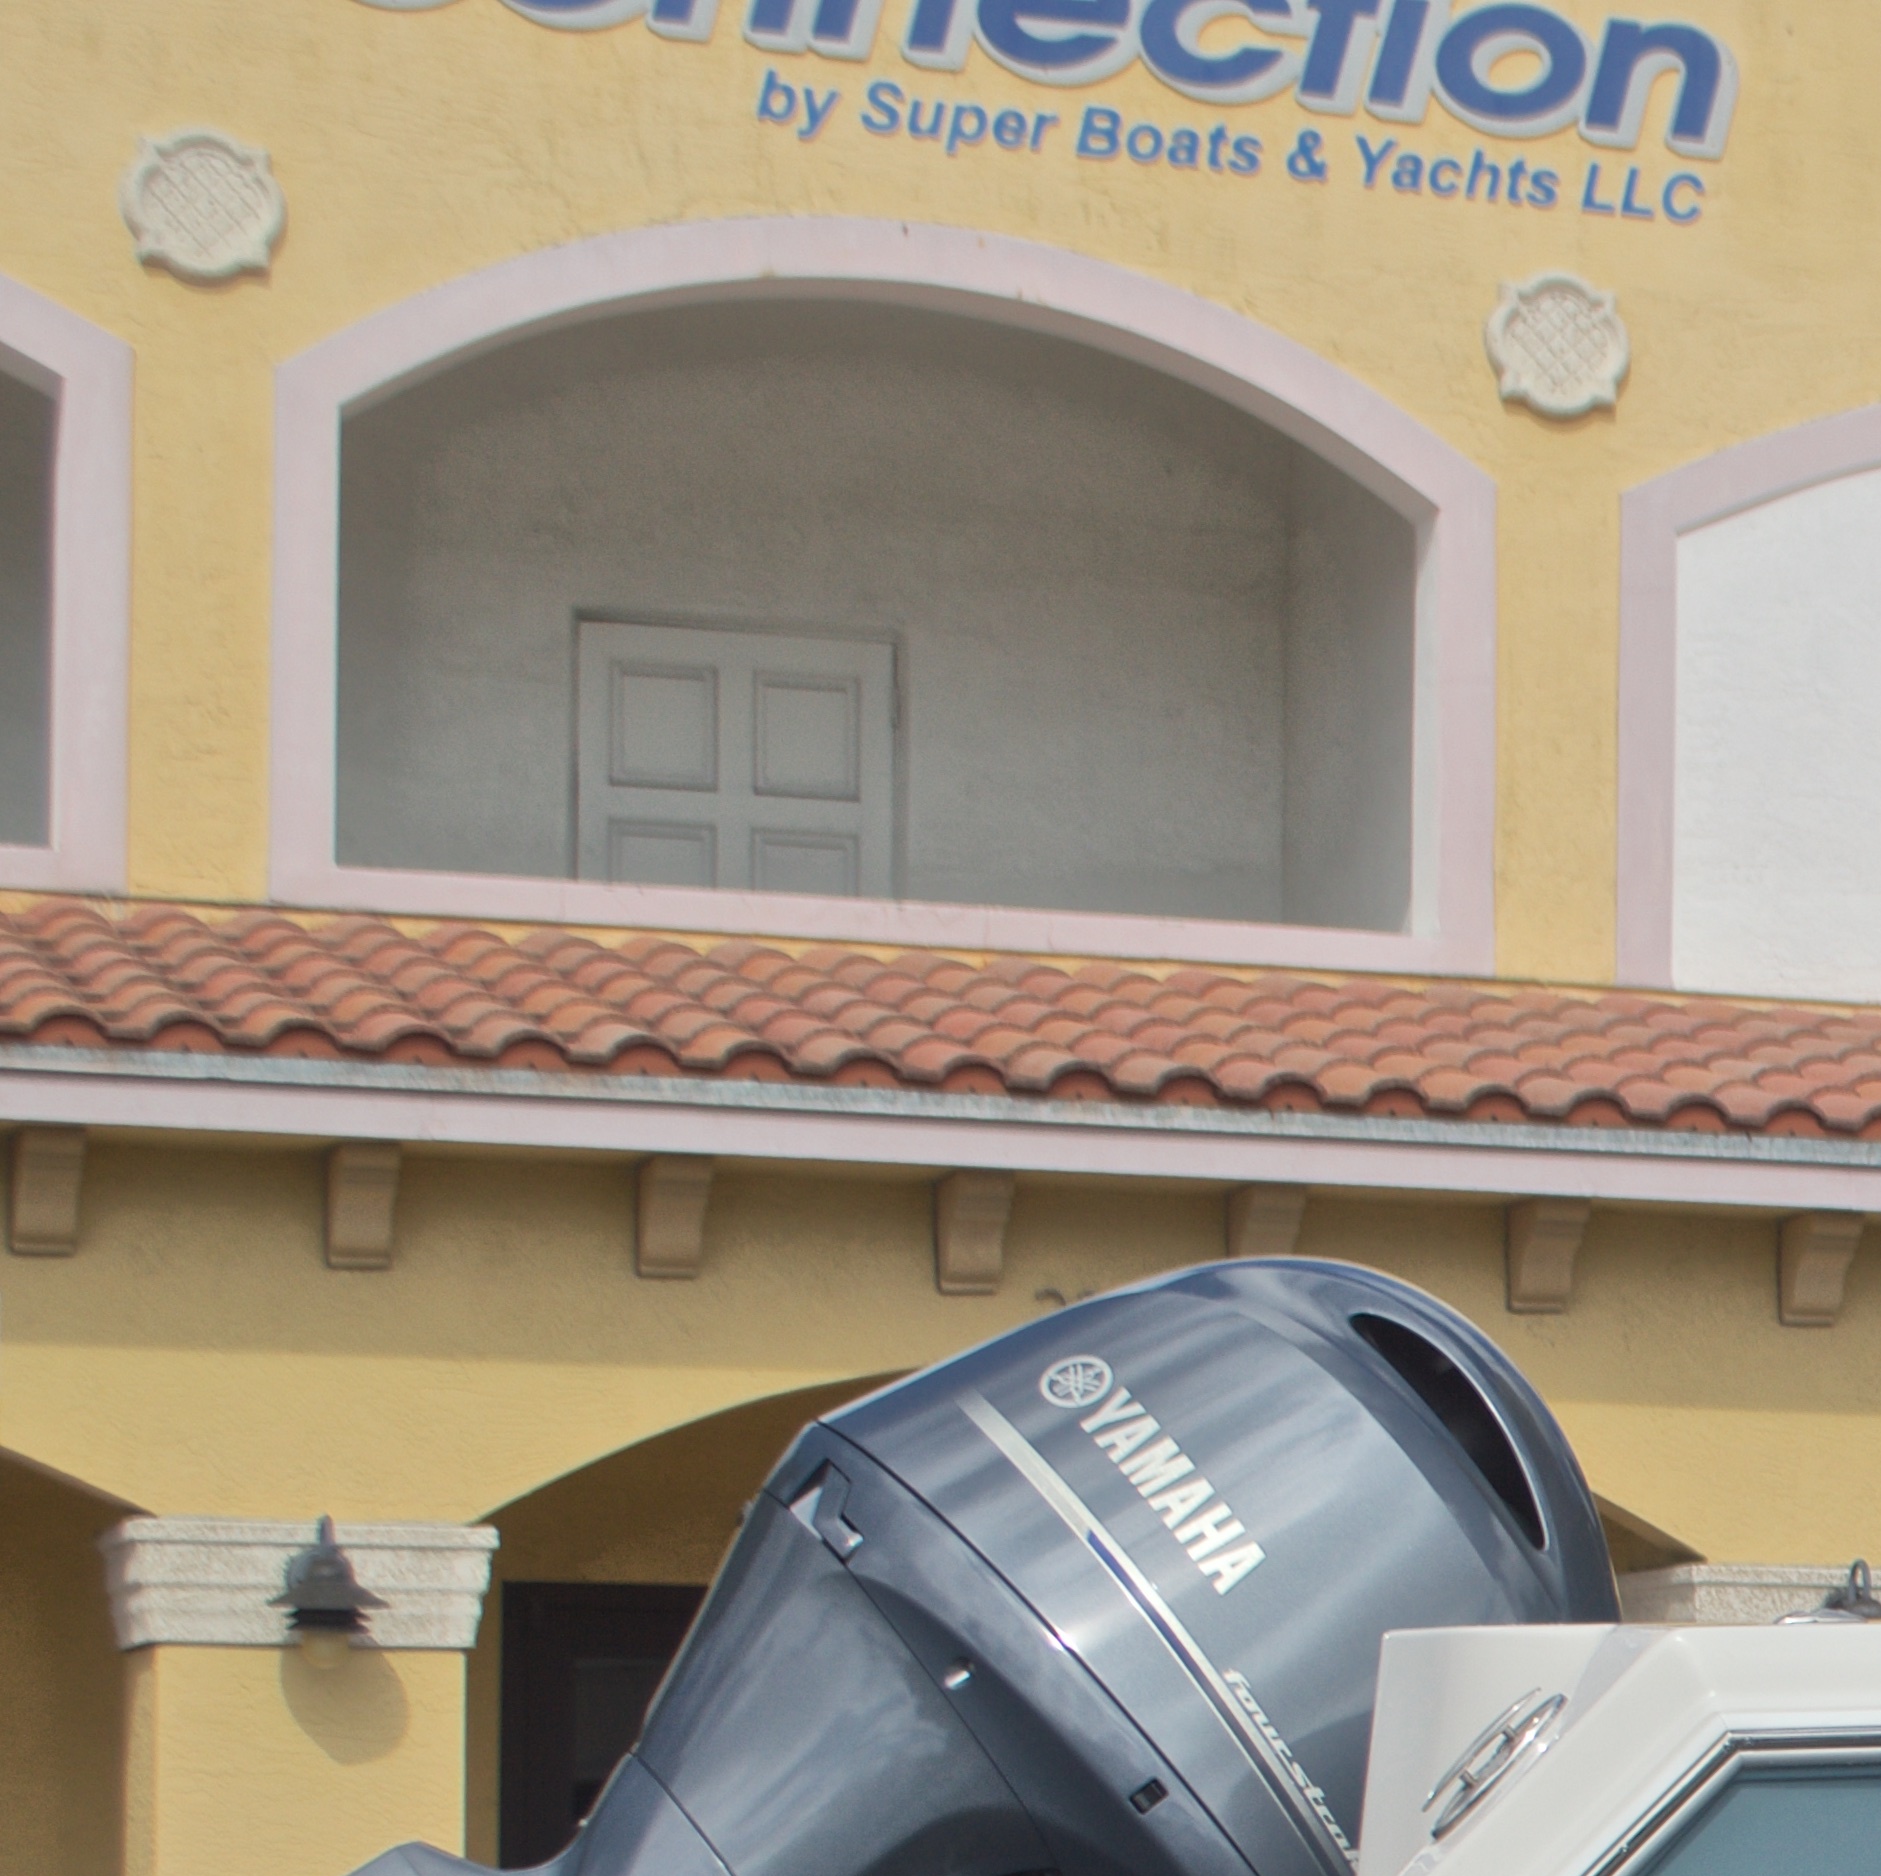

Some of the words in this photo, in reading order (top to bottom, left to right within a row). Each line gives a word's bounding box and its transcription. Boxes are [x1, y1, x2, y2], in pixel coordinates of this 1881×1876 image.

[757, 68, 838, 140] by
[860, 79, 1058, 155] Super
[1076, 105, 1263, 176] Boats
[1286, 128, 1328, 183] &
[1354, 133, 1559, 209] Yachts
[1581, 161, 1706, 224] LLC
[1079, 1386, 1267, 1596] YAMAHA
